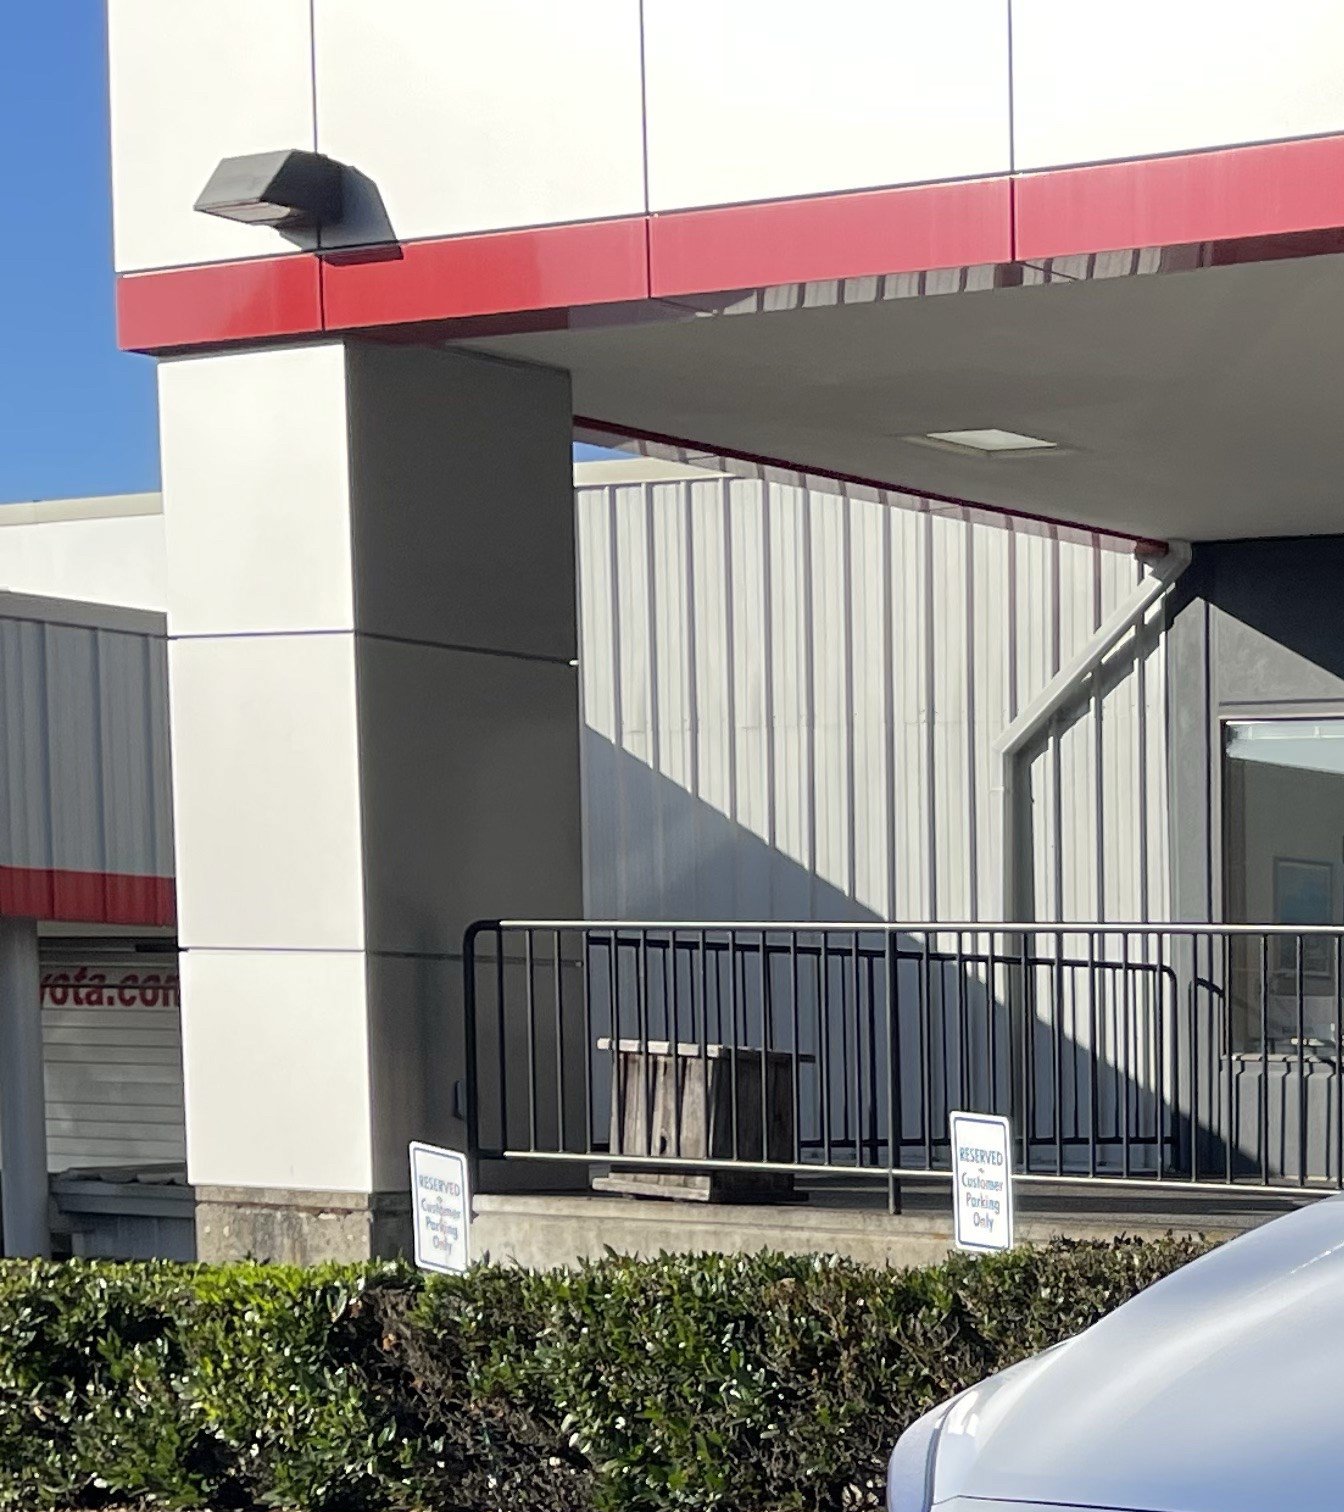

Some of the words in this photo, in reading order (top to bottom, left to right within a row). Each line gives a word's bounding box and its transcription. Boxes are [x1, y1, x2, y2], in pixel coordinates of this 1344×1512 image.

[960, 1146, 1003, 1166] RESERVED
[419, 1174, 460, 1196] RESERVED
[962, 1172, 1003, 1191] Customer
[421, 1198, 461, 1218] Customer
[966, 1191, 1000, 1215] Parking
[425, 1215, 458, 1240] Parking
[973, 1211, 994, 1232] Only
